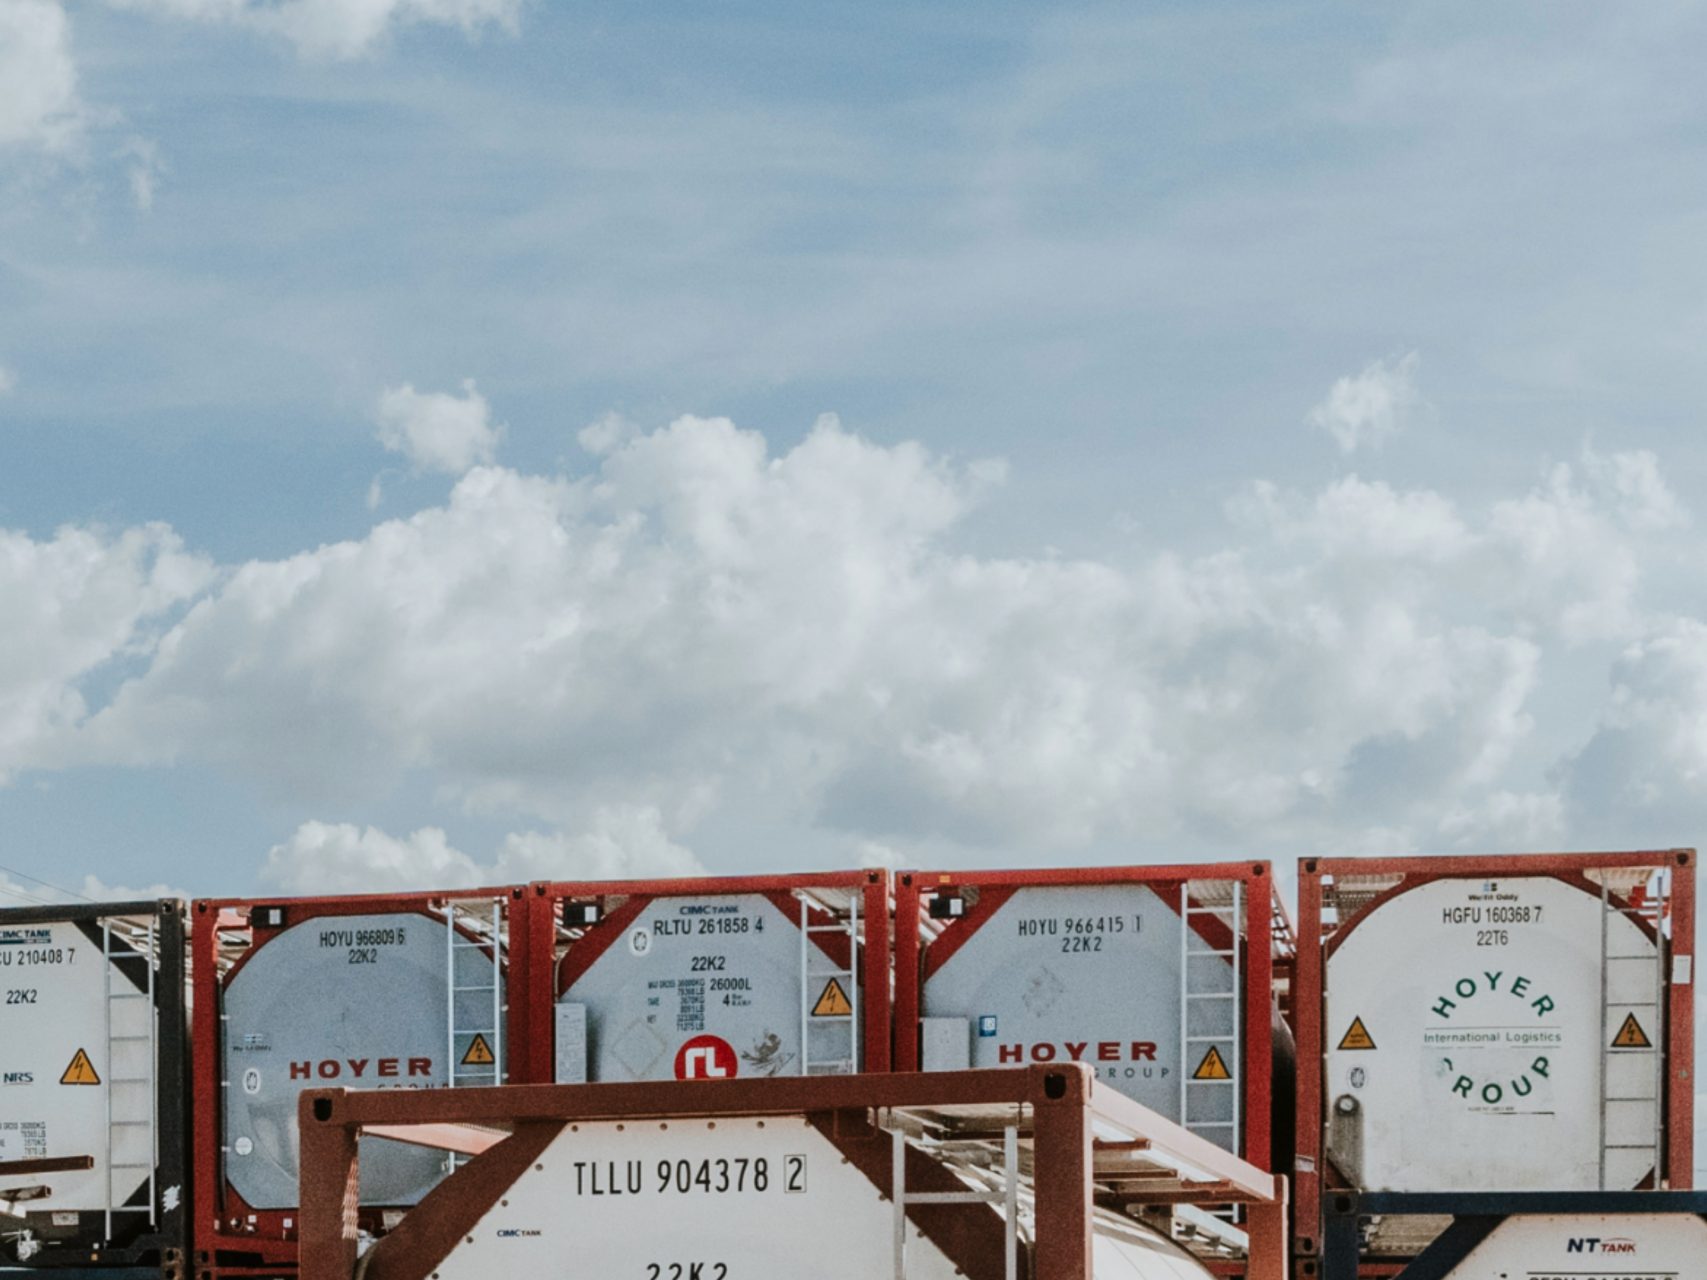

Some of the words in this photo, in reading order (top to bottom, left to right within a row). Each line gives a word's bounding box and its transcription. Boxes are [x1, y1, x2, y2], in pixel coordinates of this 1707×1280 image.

[680, 906, 711, 915] CIMC
[1443, 907, 1481, 923] HGFU
[1486, 906, 1531, 923] 160368
[1534, 906, 1542, 922] 7
[654, 919, 692, 935] RLTU
[698, 917, 749, 934] 261858
[755, 916, 764, 932] 4
[1018, 919, 1057, 936] HOYU
[1065, 916, 1124, 934] 966415
[25, 930, 51, 938] TANK
[319, 931, 353, 947] HOYU
[356, 930, 395, 946] 966809
[1477, 930, 1509, 946] 22T6
[1062, 937, 1102, 952] 22K2
[0, 951, 12, 966] U
[18, 949, 63, 966] 210408
[68, 948, 76, 964] 7
[349, 949, 378, 964] 22K2
[691, 956, 726, 971] 22K2
[710, 978, 752, 991] 26000L
[6, 989, 38, 1004] 22K2
[723, 994, 730, 1006] 4
[1432, 971, 1555, 1019] HOYER
[1424, 1032, 1499, 1043] International
[1506, 1032, 1562, 1044] Logistics
[998, 1041, 1158, 1063] HOYER
[290, 1058, 433, 1080] HOYER
[3, 1072, 34, 1083] NRS
[574, 1160, 642, 1195] TLLU
[657, 1158, 769, 1193] 904378
[788, 1157, 803, 1190] 2
[497, 1229, 520, 1237] CIMC
[1567, 1238, 1600, 1252] NT
[1600, 1243, 1637, 1252] TANK
